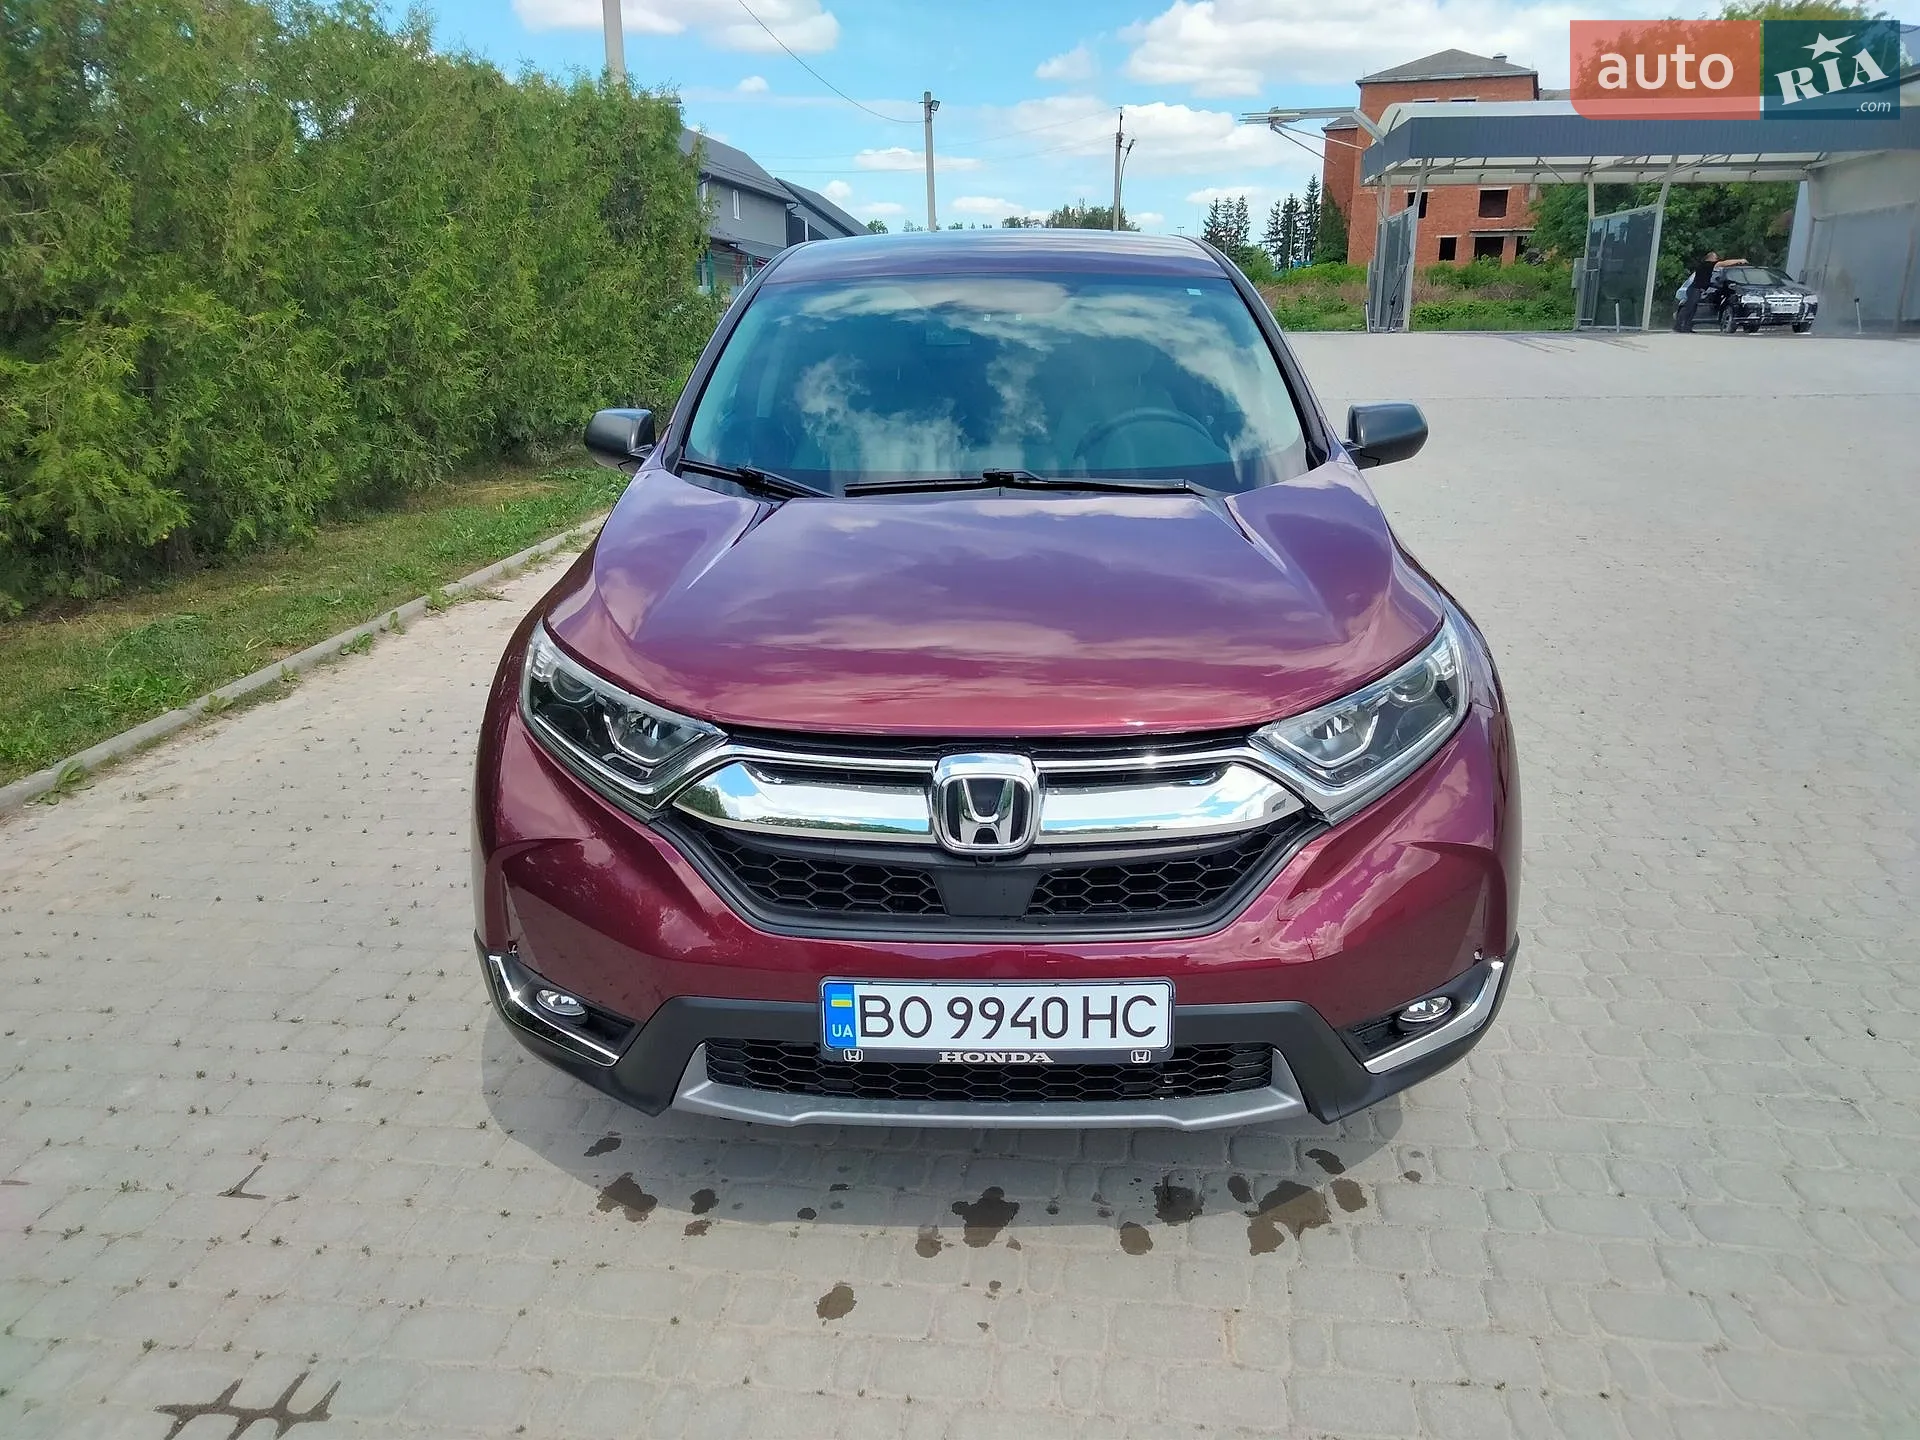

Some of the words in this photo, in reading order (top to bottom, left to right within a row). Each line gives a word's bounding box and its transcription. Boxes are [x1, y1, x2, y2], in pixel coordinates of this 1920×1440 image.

[858, 995, 932, 1038] BO
[946, 996, 1068, 1039] 9940
[1082, 996, 1157, 1039] HC
[832, 1023, 853, 1038] UA
[939, 1051, 1053, 1063] HONDA
